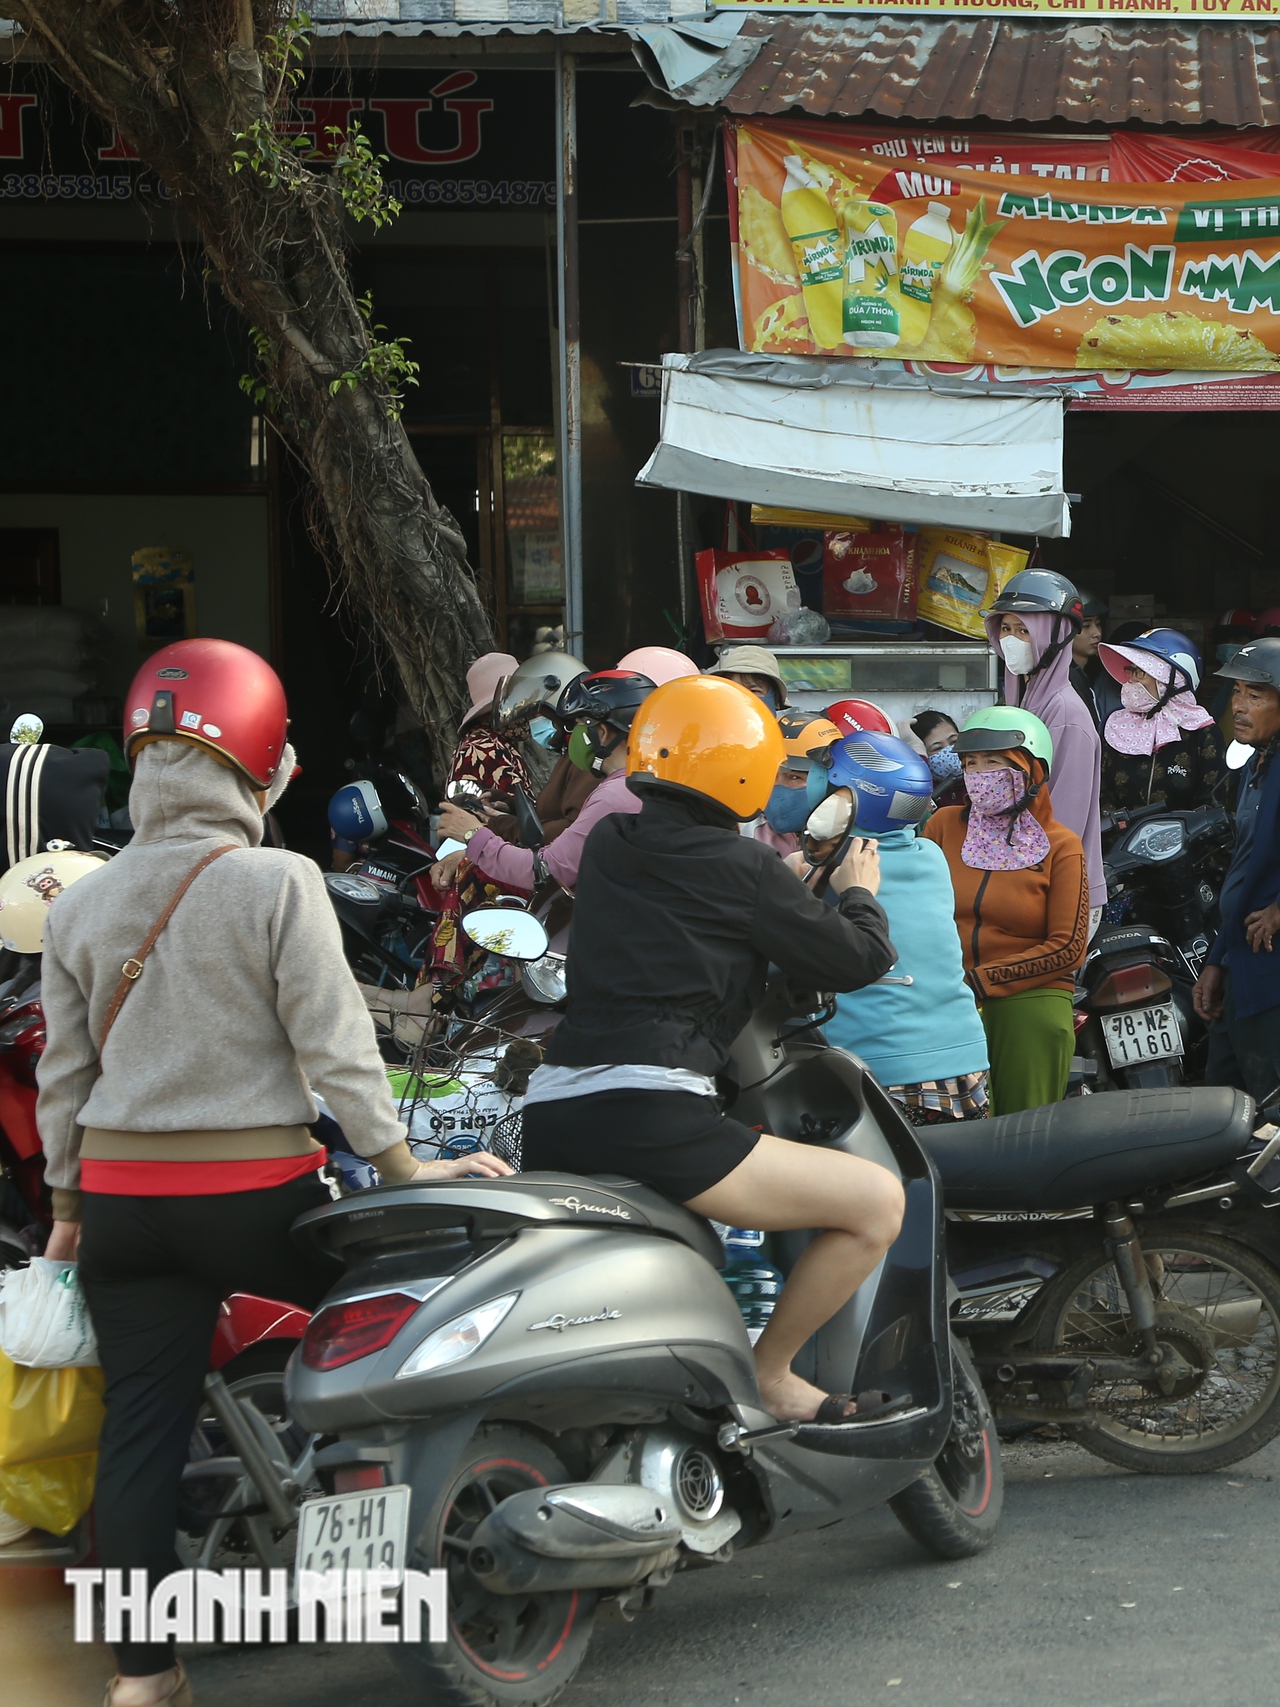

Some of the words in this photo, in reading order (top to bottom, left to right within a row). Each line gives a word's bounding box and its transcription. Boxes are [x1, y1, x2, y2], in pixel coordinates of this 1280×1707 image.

[989, 243, 1176, 328] NGON
[367, 865, 398, 883] YAMAHA
[1102, 931, 1143, 944] HONDA
[1118, 1031, 1172, 1061] 1160
[563, 1195, 631, 1220] Grande
[996, 1211, 1050, 1221] HONDA
[550, 1306, 623, 1332] Grande
